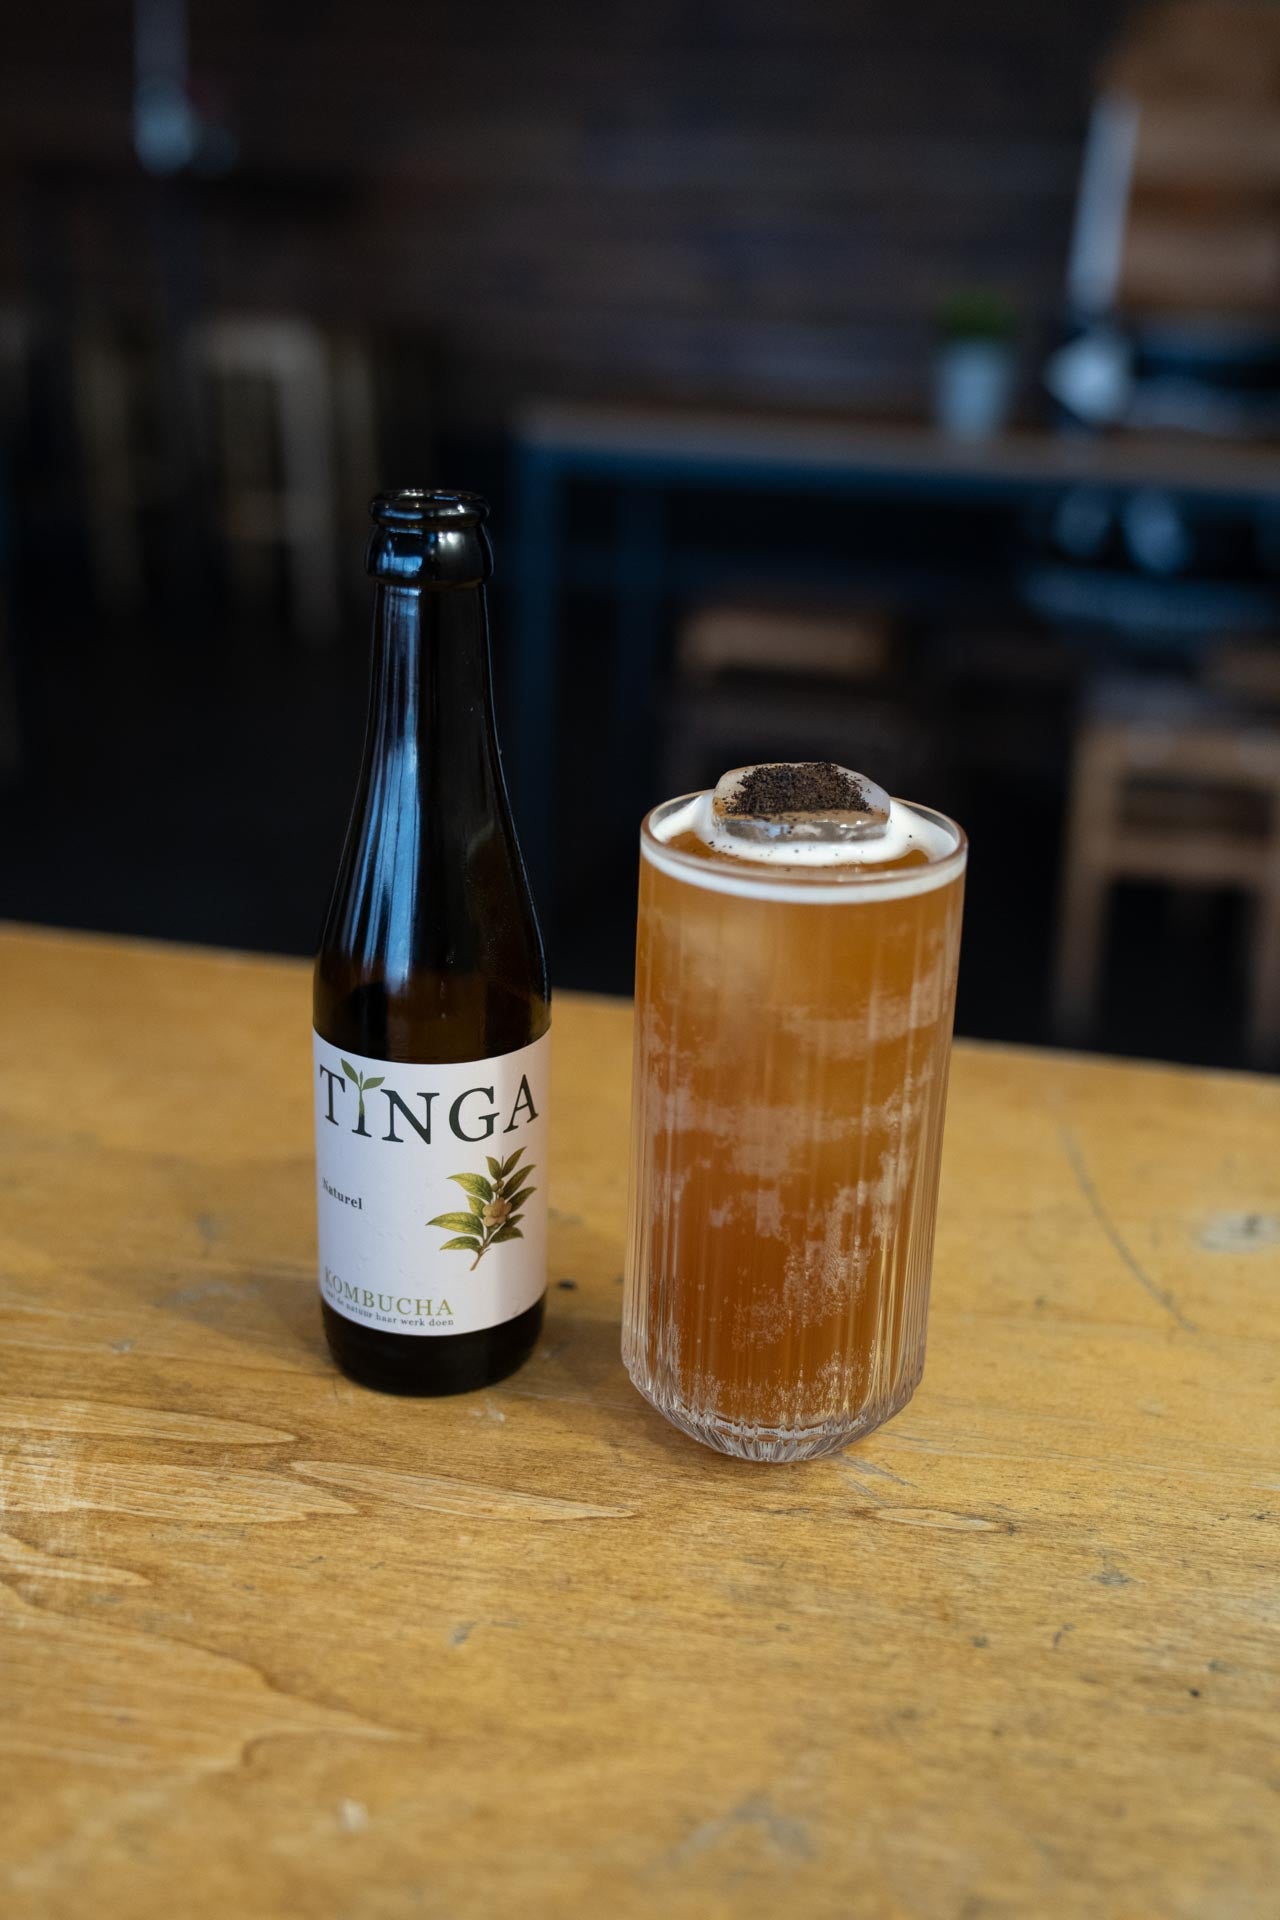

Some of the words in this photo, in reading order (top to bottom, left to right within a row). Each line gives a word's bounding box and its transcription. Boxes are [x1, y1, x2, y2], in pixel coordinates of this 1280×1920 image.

[319, 1059, 539, 1144] TINGA
[322, 1177, 362, 1210] Naturel
[325, 1265, 453, 1316] KOMBUCHA
[375, 1312, 397, 1324] haar
[401, 1317, 426, 1327] werk
[428, 1318, 454, 1327] doen
